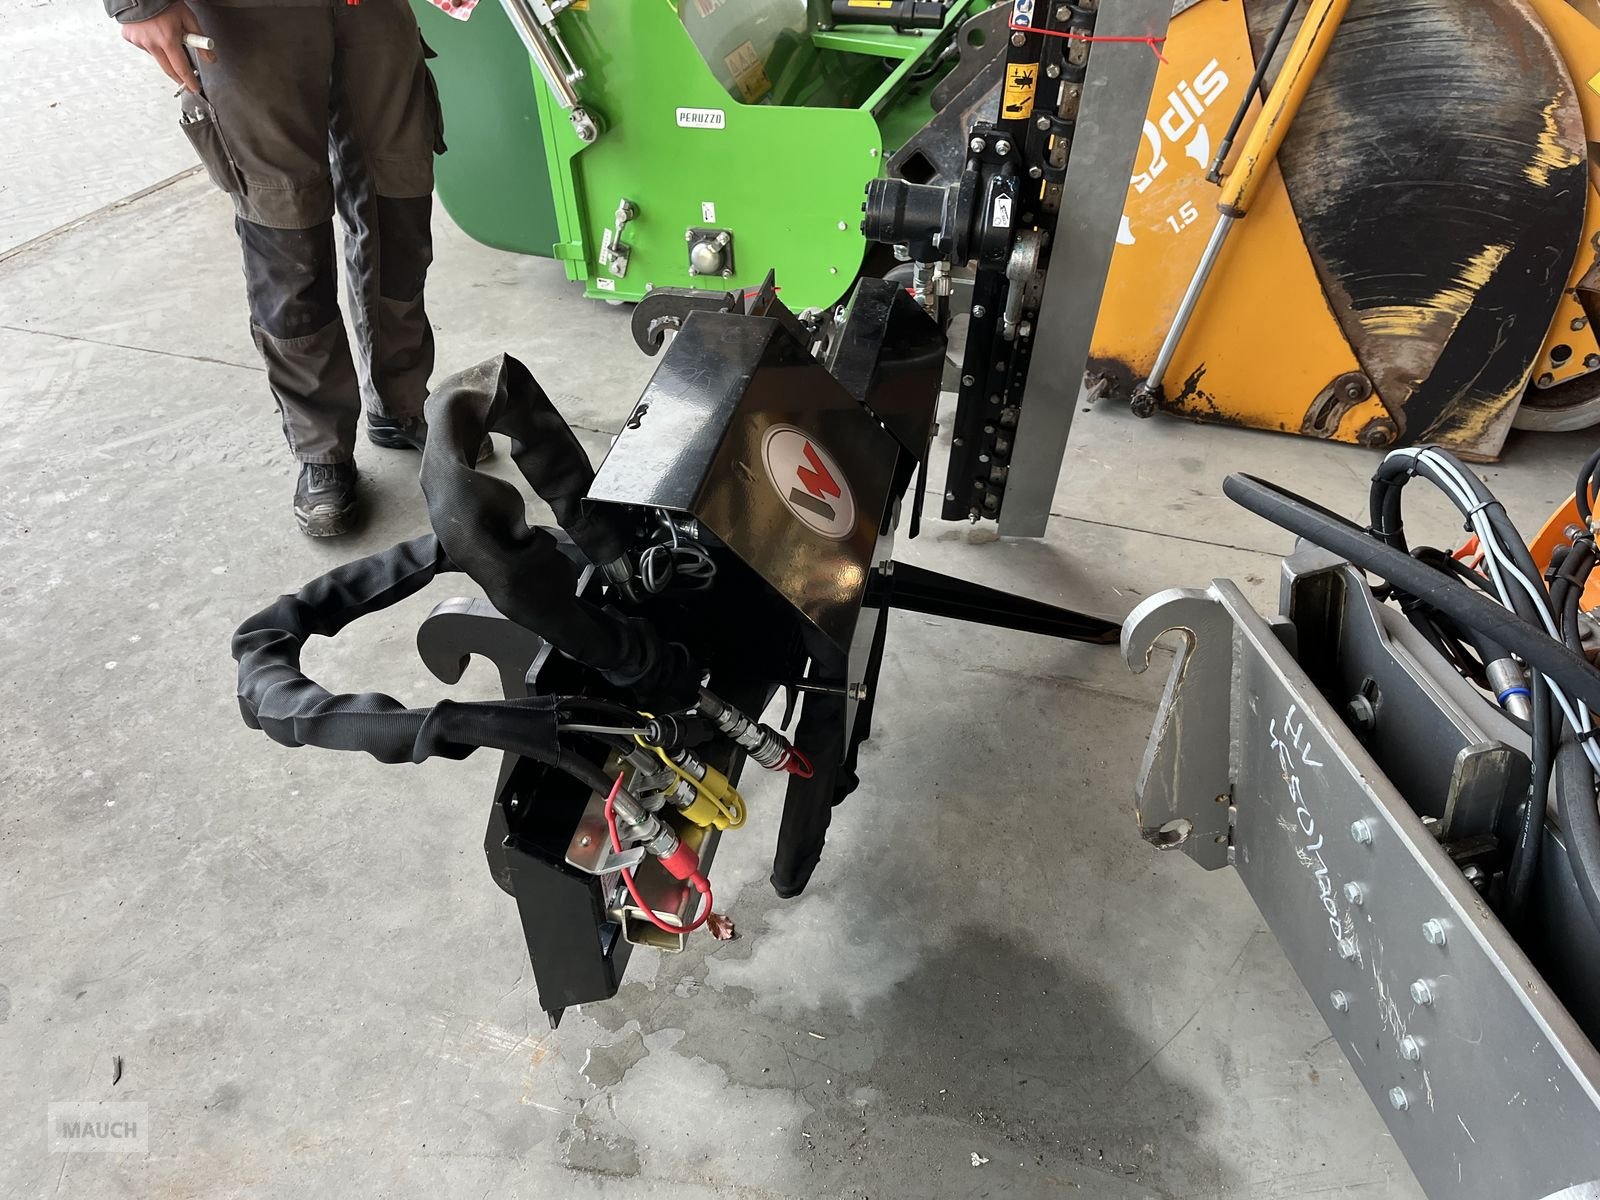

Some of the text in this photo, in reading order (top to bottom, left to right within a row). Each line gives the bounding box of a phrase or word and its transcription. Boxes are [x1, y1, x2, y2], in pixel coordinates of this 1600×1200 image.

[679, 112, 722, 124] PERUZZO
[1166, 200, 1199, 234] 1.5
[1283, 704, 1324, 767] HV
